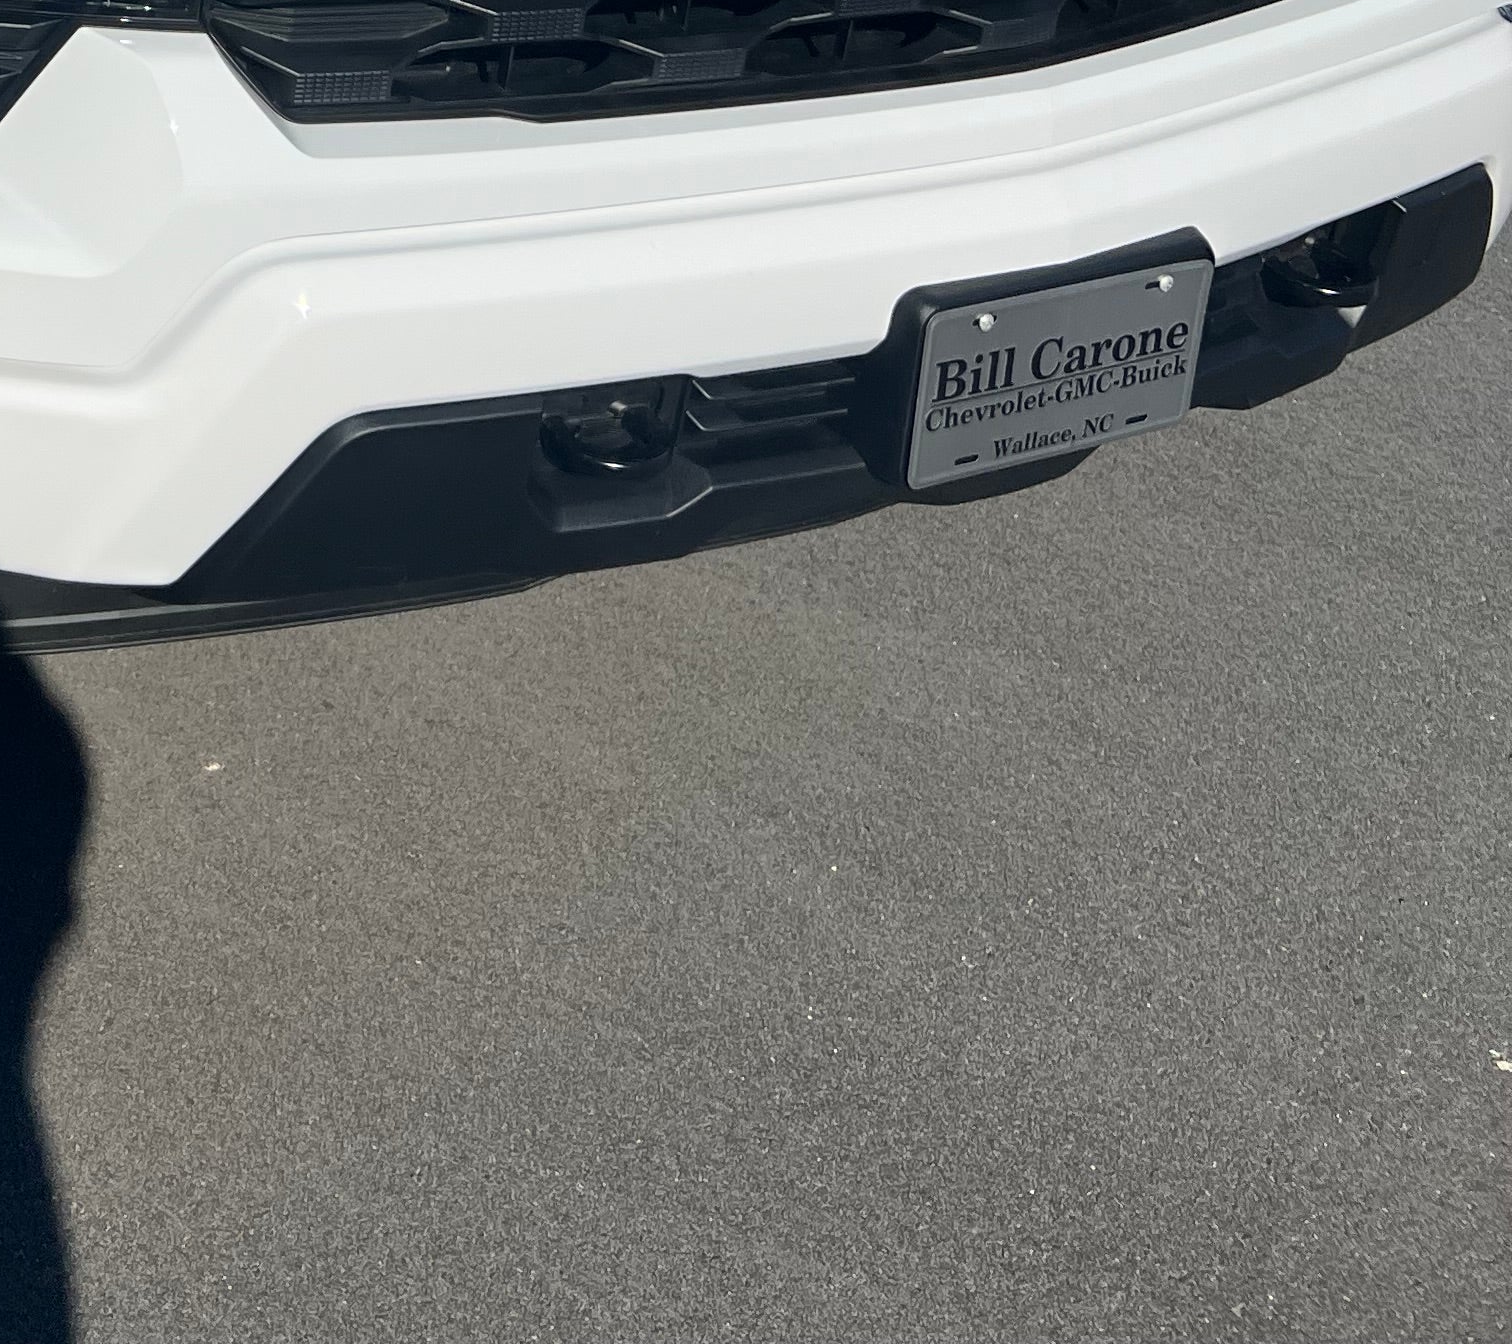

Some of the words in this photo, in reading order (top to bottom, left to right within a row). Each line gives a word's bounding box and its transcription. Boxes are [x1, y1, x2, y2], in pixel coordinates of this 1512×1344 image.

[925, 355, 1188, 433] Chevrolet-GMC-Buick
[931, 346, 1016, 403] Bill
[1030, 321, 1189, 380] Carone
[993, 427, 1076, 459] Wallace,
[1081, 413, 1115, 439] NC
